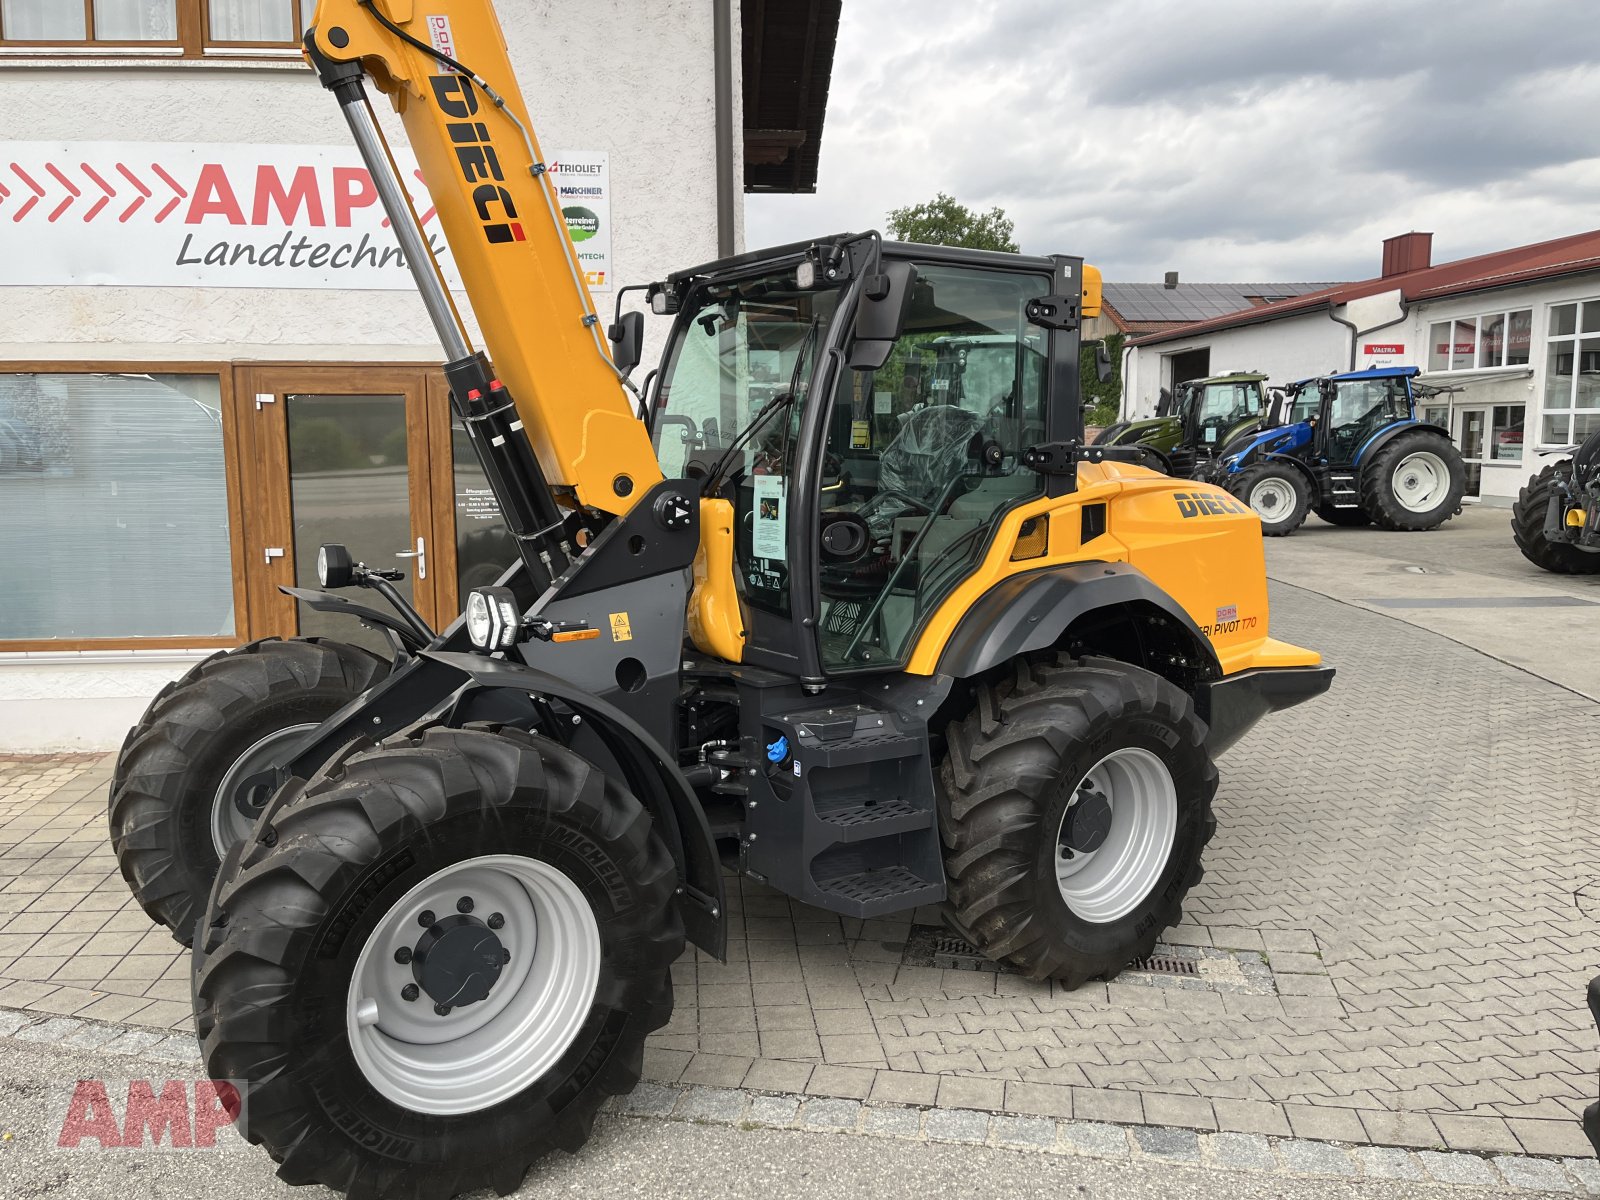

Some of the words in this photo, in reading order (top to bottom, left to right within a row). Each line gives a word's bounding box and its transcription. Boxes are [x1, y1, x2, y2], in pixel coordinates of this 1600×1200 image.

[558, 164, 603, 173] TRIOLIET
[184, 163, 378, 227] AMP
[560, 187, 603, 195] MARCHNER
[566, 216, 596, 225] terreiner
[176, 230, 446, 269] Landtechn
[585, 271, 605, 285] CI
[1217, 608, 1236, 617] DORN
[1214, 620, 1240, 635] PIVOT
[1242, 616, 1257, 631] T70
[550, 826, 633, 912] MICHELIN
